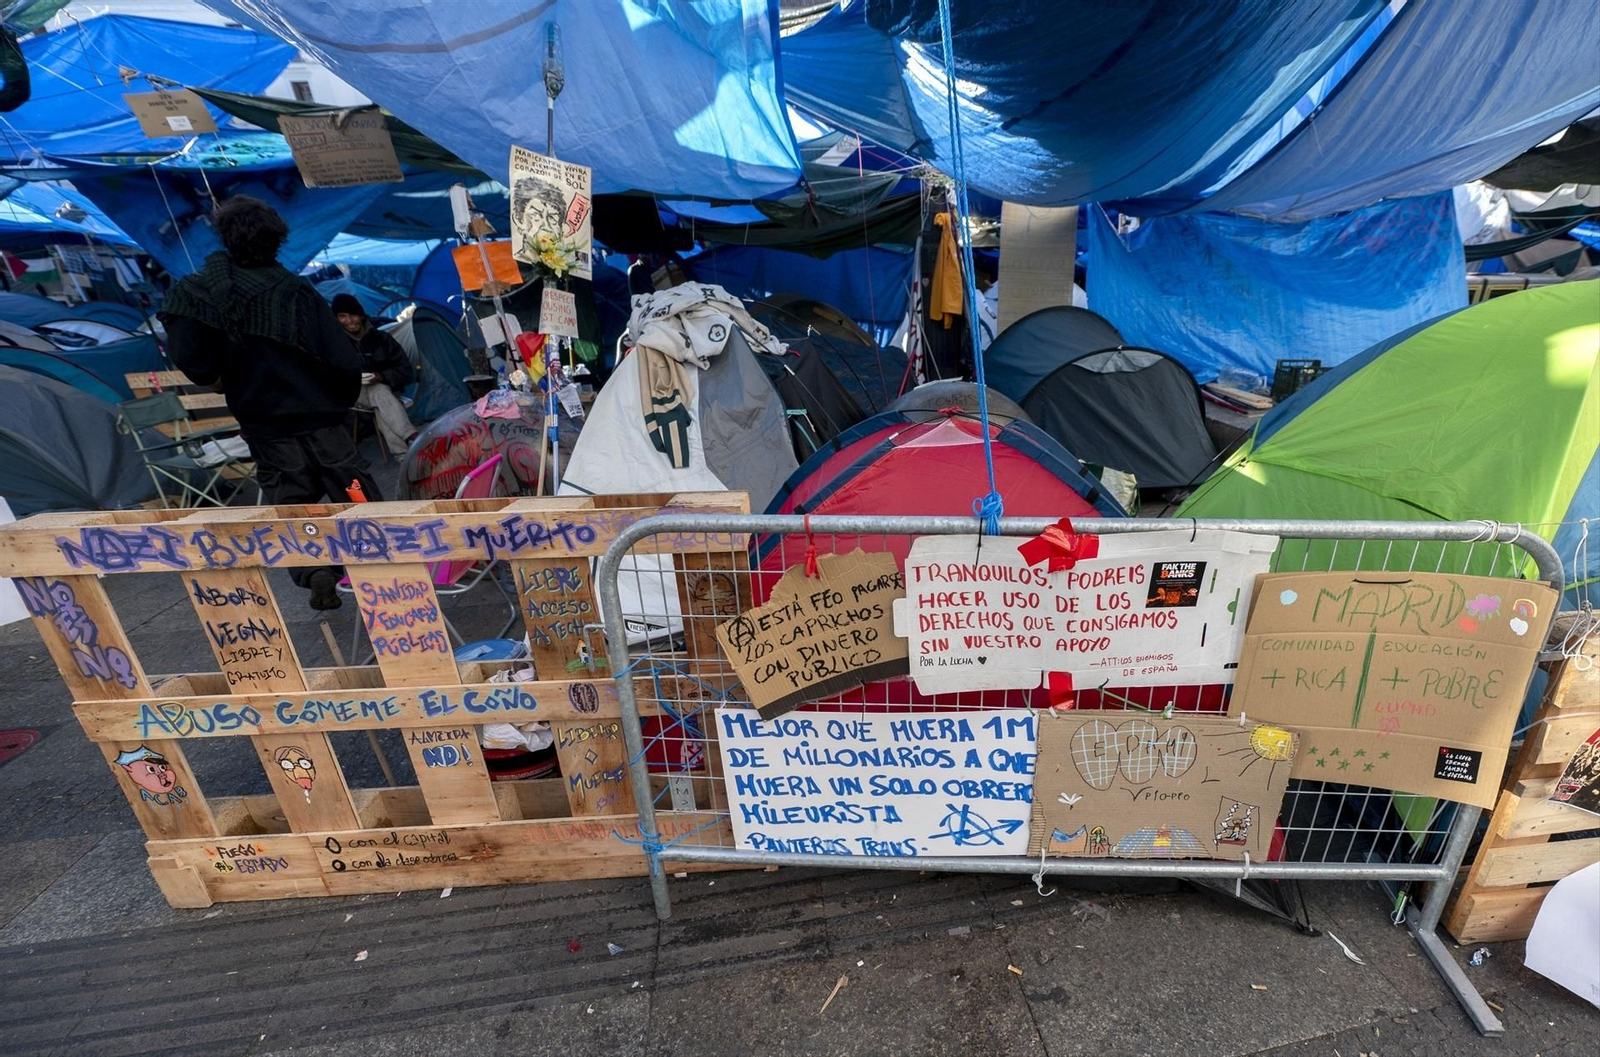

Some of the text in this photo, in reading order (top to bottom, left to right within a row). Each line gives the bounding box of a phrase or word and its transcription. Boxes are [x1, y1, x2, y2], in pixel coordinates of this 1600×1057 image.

[515, 155, 528, 164] POR
[578, 174, 587, 183] EL
[566, 178, 585, 190] SOL
[56, 525, 192, 571] NAZI
[191, 523, 324, 568] BUENO
[325, 518, 453, 563] NAZI
[461, 513, 597, 559] MUERTO
[519, 564, 583, 598] LIBRE
[1067, 564, 1146, 590] PODREIS
[1160, 569, 1196, 579] BANKS
[11, 577, 82, 619] NO
[191, 578, 267, 607] ABORTO
[357, 578, 429, 607] SANIDAD
[758, 572, 906, 632] ESTÁ FEO PAGARSE
[918, 590, 1132, 614] HACER USO DE LOS
[360, 606, 376, 634] Y
[526, 598, 591, 619] ACCESO
[1312, 579, 1468, 636] MADRID
[53, 605, 99, 647] ES
[743, 603, 884, 665] LOS CAPRICHOS
[919, 609, 1179, 634] DERECHOS QUE CONSIGAMOS
[373, 630, 449, 657] PÚBLICAS
[531, 625, 551, 645] A
[920, 634, 1111, 654] SIN VUESTRO APOYO
[1261, 638, 1355, 652] COMUNIDAD
[220, 646, 282, 666] LIBRE Y
[753, 627, 879, 684] CON DINERO
[938, 656, 947, 666] LA
[950, 656, 973, 666] LUCHA
[1382, 640, 1488, 660] EDUCACIÓN
[70, 645, 138, 689] NO
[227, 667, 286, 686] GRATUITO
[786, 649, 882, 688] PÚBLICO
[1123, 662, 1178, 677] DE ESPAÑA
[1261, 667, 1347, 692] + RICA
[1380, 667, 1504, 708] + POBRE
[136, 700, 262, 738] ABUSO
[416, 688, 458, 719] EL
[462, 684, 539, 715] COÑO
[408, 728, 470, 745] ALMEIDA
[722, 713, 819, 738] MEJOR
[827, 718, 876, 743] QUE
[890, 717, 975, 743] MUERA
[727, 748, 769, 768] DE
[964, 748, 982, 768] A
[988, 748, 1038, 775] QUE
[141, 785, 188, 806] ACAB
[735, 774, 821, 798] MUERA
[828, 776, 864, 797] UN
[868, 775, 937, 797] SOLO
[349, 839, 378, 848] con
[383, 832, 400, 846] el
[404, 830, 452, 848] capital
[234, 857, 289, 875] ESTADO
[352, 860, 373, 869] con
[422, 852, 460, 864] obrera
